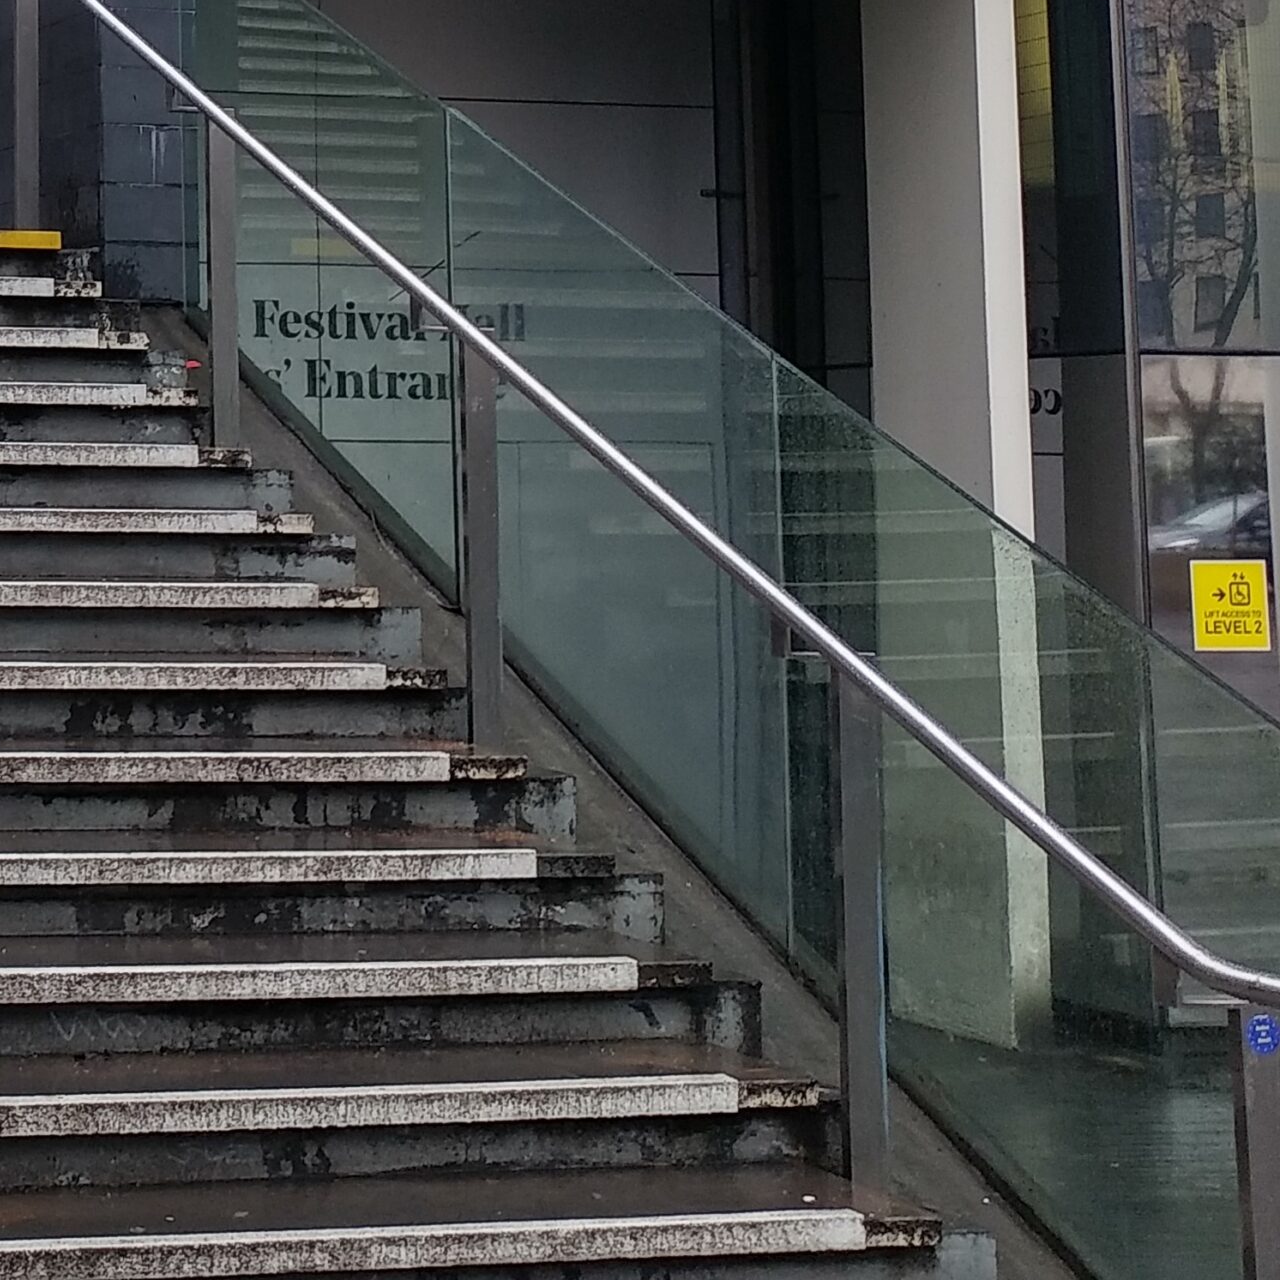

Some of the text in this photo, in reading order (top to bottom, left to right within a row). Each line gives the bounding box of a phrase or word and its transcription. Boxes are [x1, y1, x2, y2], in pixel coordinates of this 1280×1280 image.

[252, 299, 526, 342] Festiva ll
[303, 359, 507, 401] Entra
[1204, 610, 1262, 618] LIFT ACCESS TO
[1205, 620, 1263, 635] LEVEL 2
